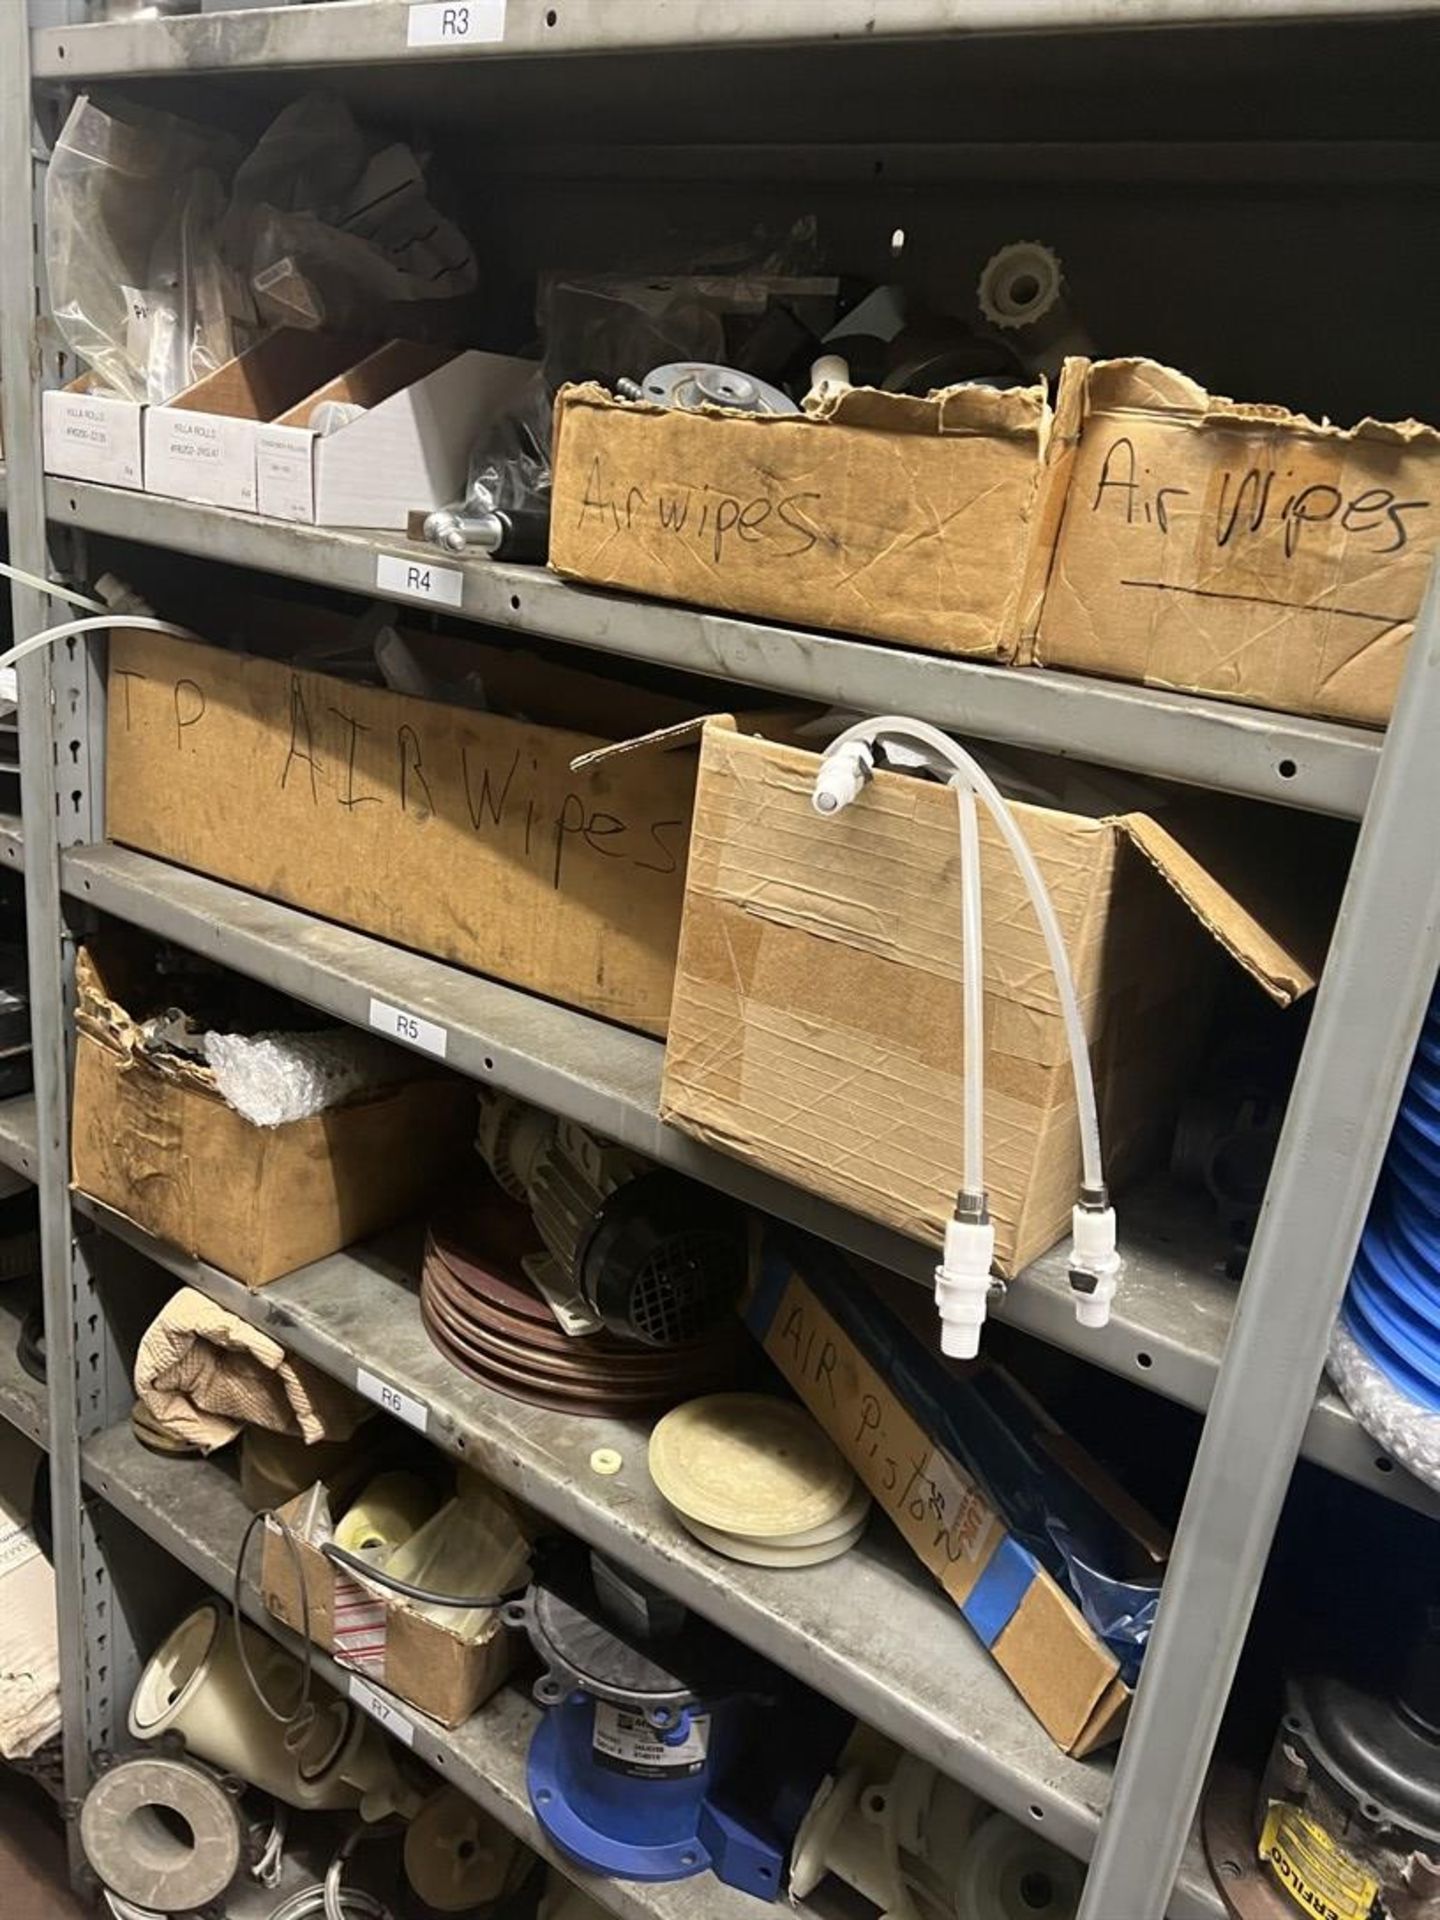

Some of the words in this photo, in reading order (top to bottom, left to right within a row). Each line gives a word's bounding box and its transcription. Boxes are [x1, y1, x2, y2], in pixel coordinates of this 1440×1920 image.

[442, 7, 470, 36] R3
[1092, 436, 1190, 535] Air
[1215, 468, 1430, 559] Wipes
[407, 566, 431, 593] R4
[280, 672, 438, 817] AIR
[460, 746, 684, 891] Wipes
[396, 1014, 419, 1040] R5
[782, 1306, 838, 1409] AIR
[382, 1386, 402, 1412] R6
[370, 1697, 391, 1721] R7
[1270, 1846, 1339, 1920] ERFILCO
